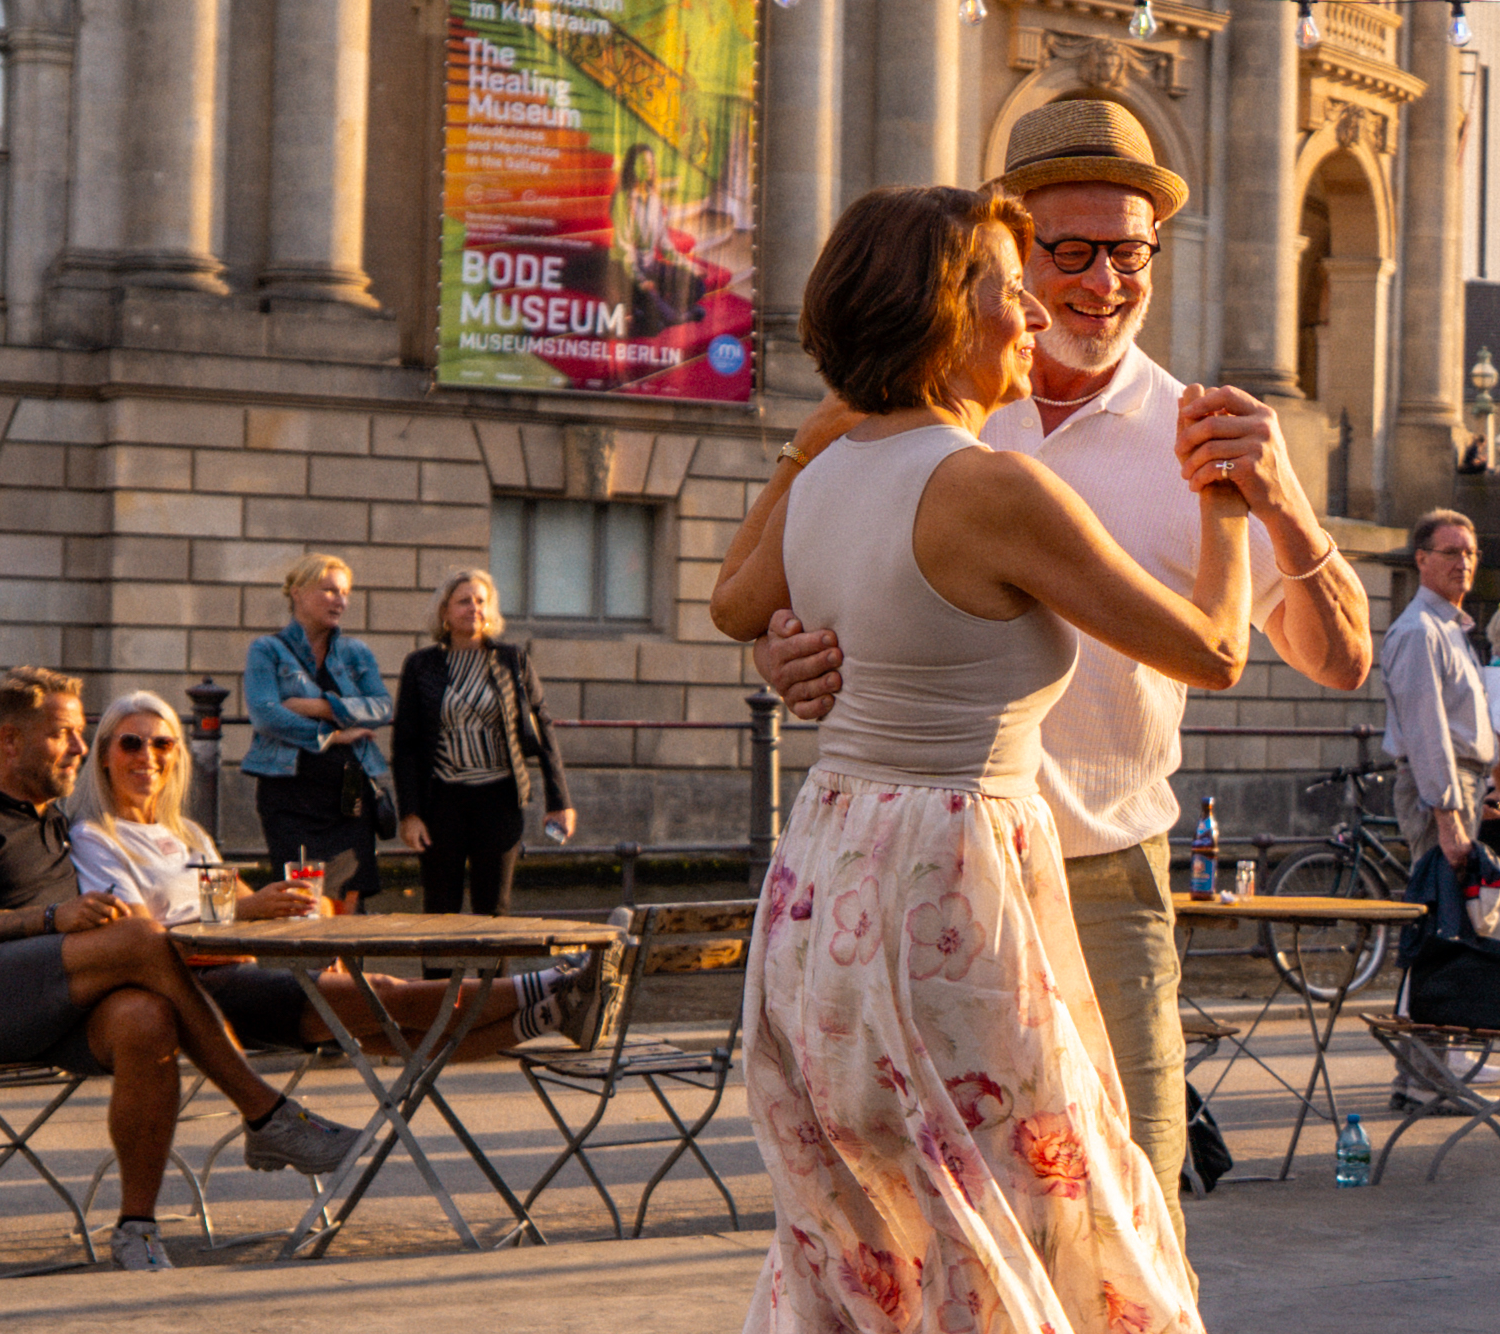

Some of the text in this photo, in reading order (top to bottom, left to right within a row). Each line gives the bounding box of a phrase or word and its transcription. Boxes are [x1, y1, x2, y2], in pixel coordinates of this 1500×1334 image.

[501, 0, 611, 36] Kunstraum
[464, 36, 516, 67] The
[468, 64, 572, 107] Healing
[467, 91, 582, 129] Museum
[461, 249, 564, 291] BODE
[460, 290, 625, 339] MUSEUM
[459, 331, 681, 365] MUSEUMSINSEL BERLIN
